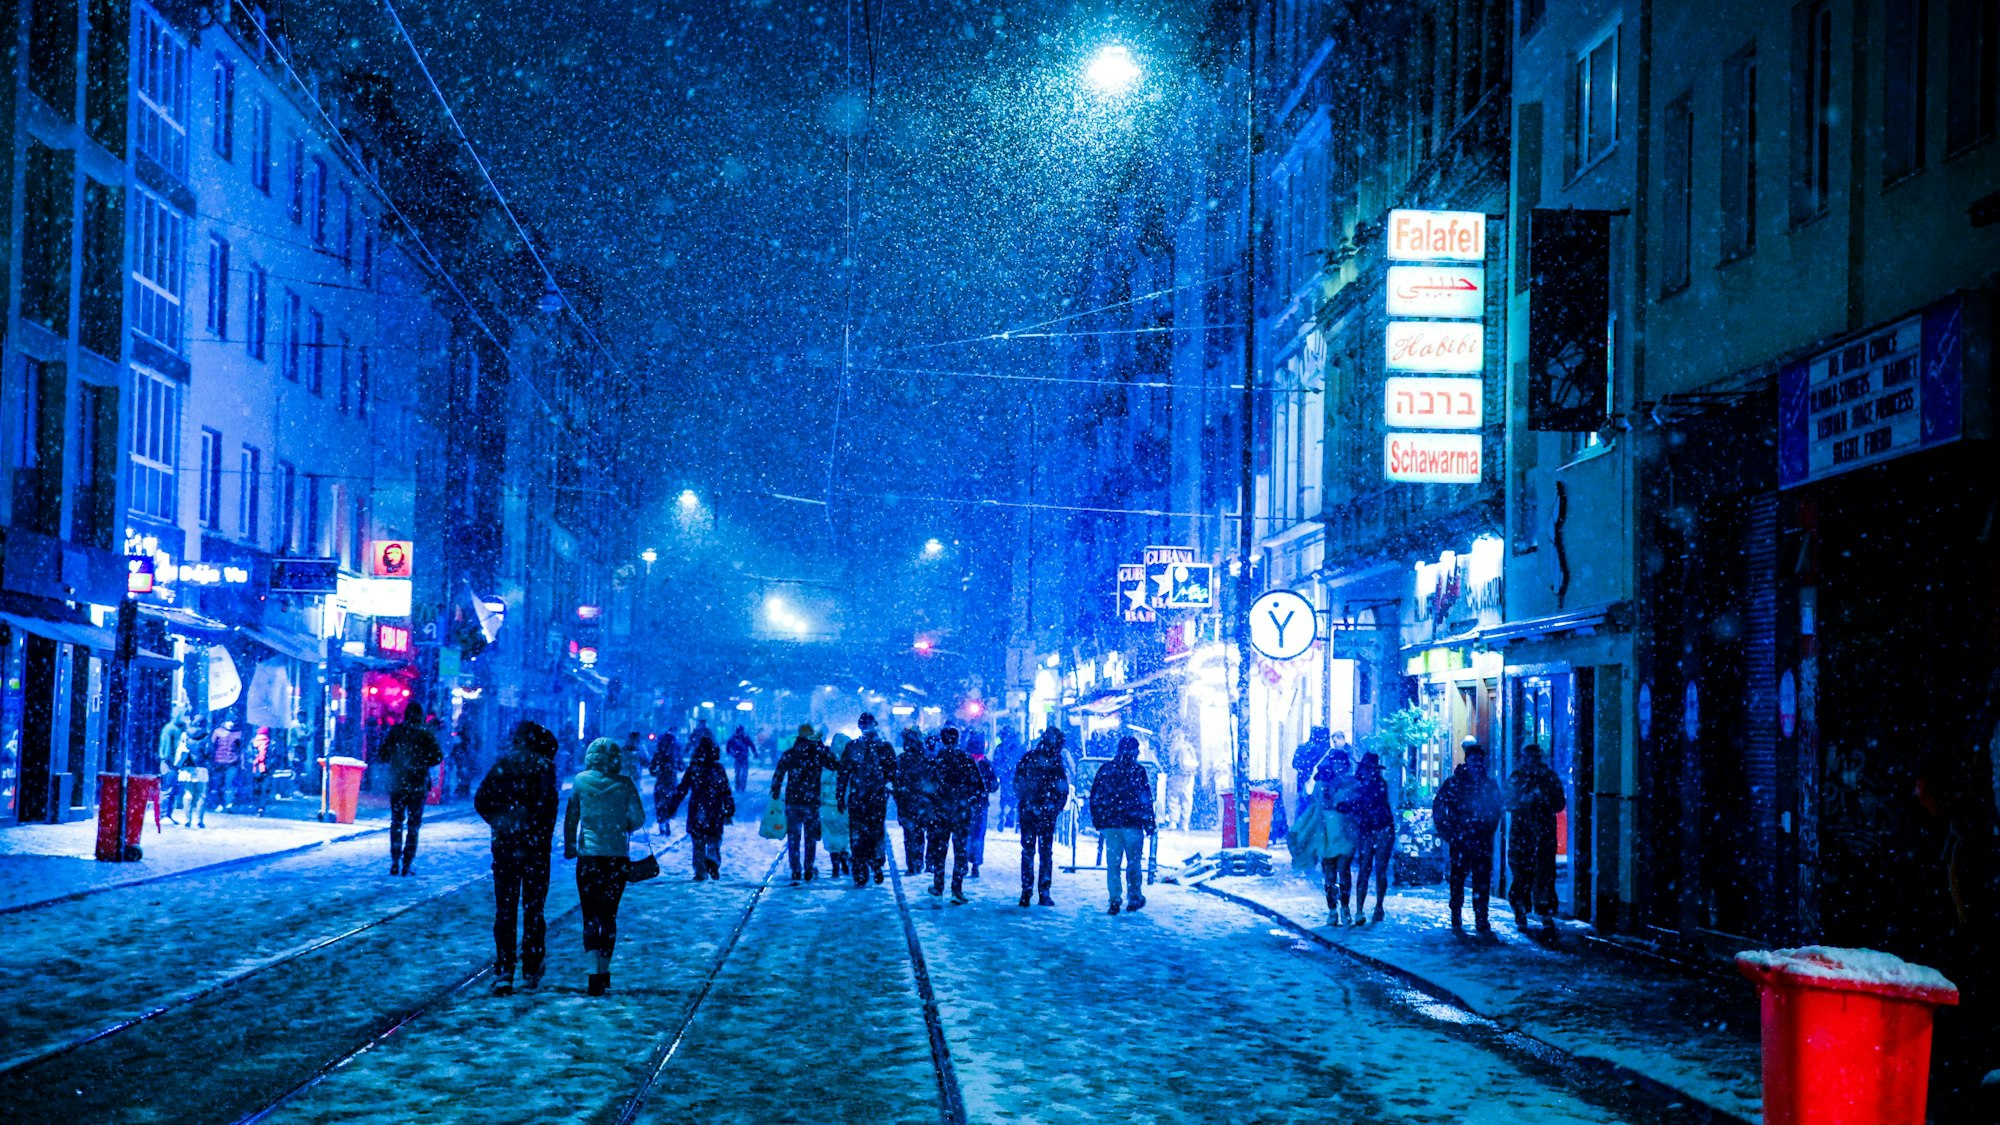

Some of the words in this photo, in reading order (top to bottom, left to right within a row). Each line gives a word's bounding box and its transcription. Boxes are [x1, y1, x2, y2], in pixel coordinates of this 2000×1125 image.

[1395, 217, 1480, 253] Falafel
[1392, 331, 1478, 363] Habibi
[1396, 390, 1476, 416] ברכה
[1390, 440, 1479, 475] Schawarma
[1146, 548, 1193, 565] CUBANA
[1119, 567, 1145, 582] CUB
[1124, 610, 1156, 622] BAR
